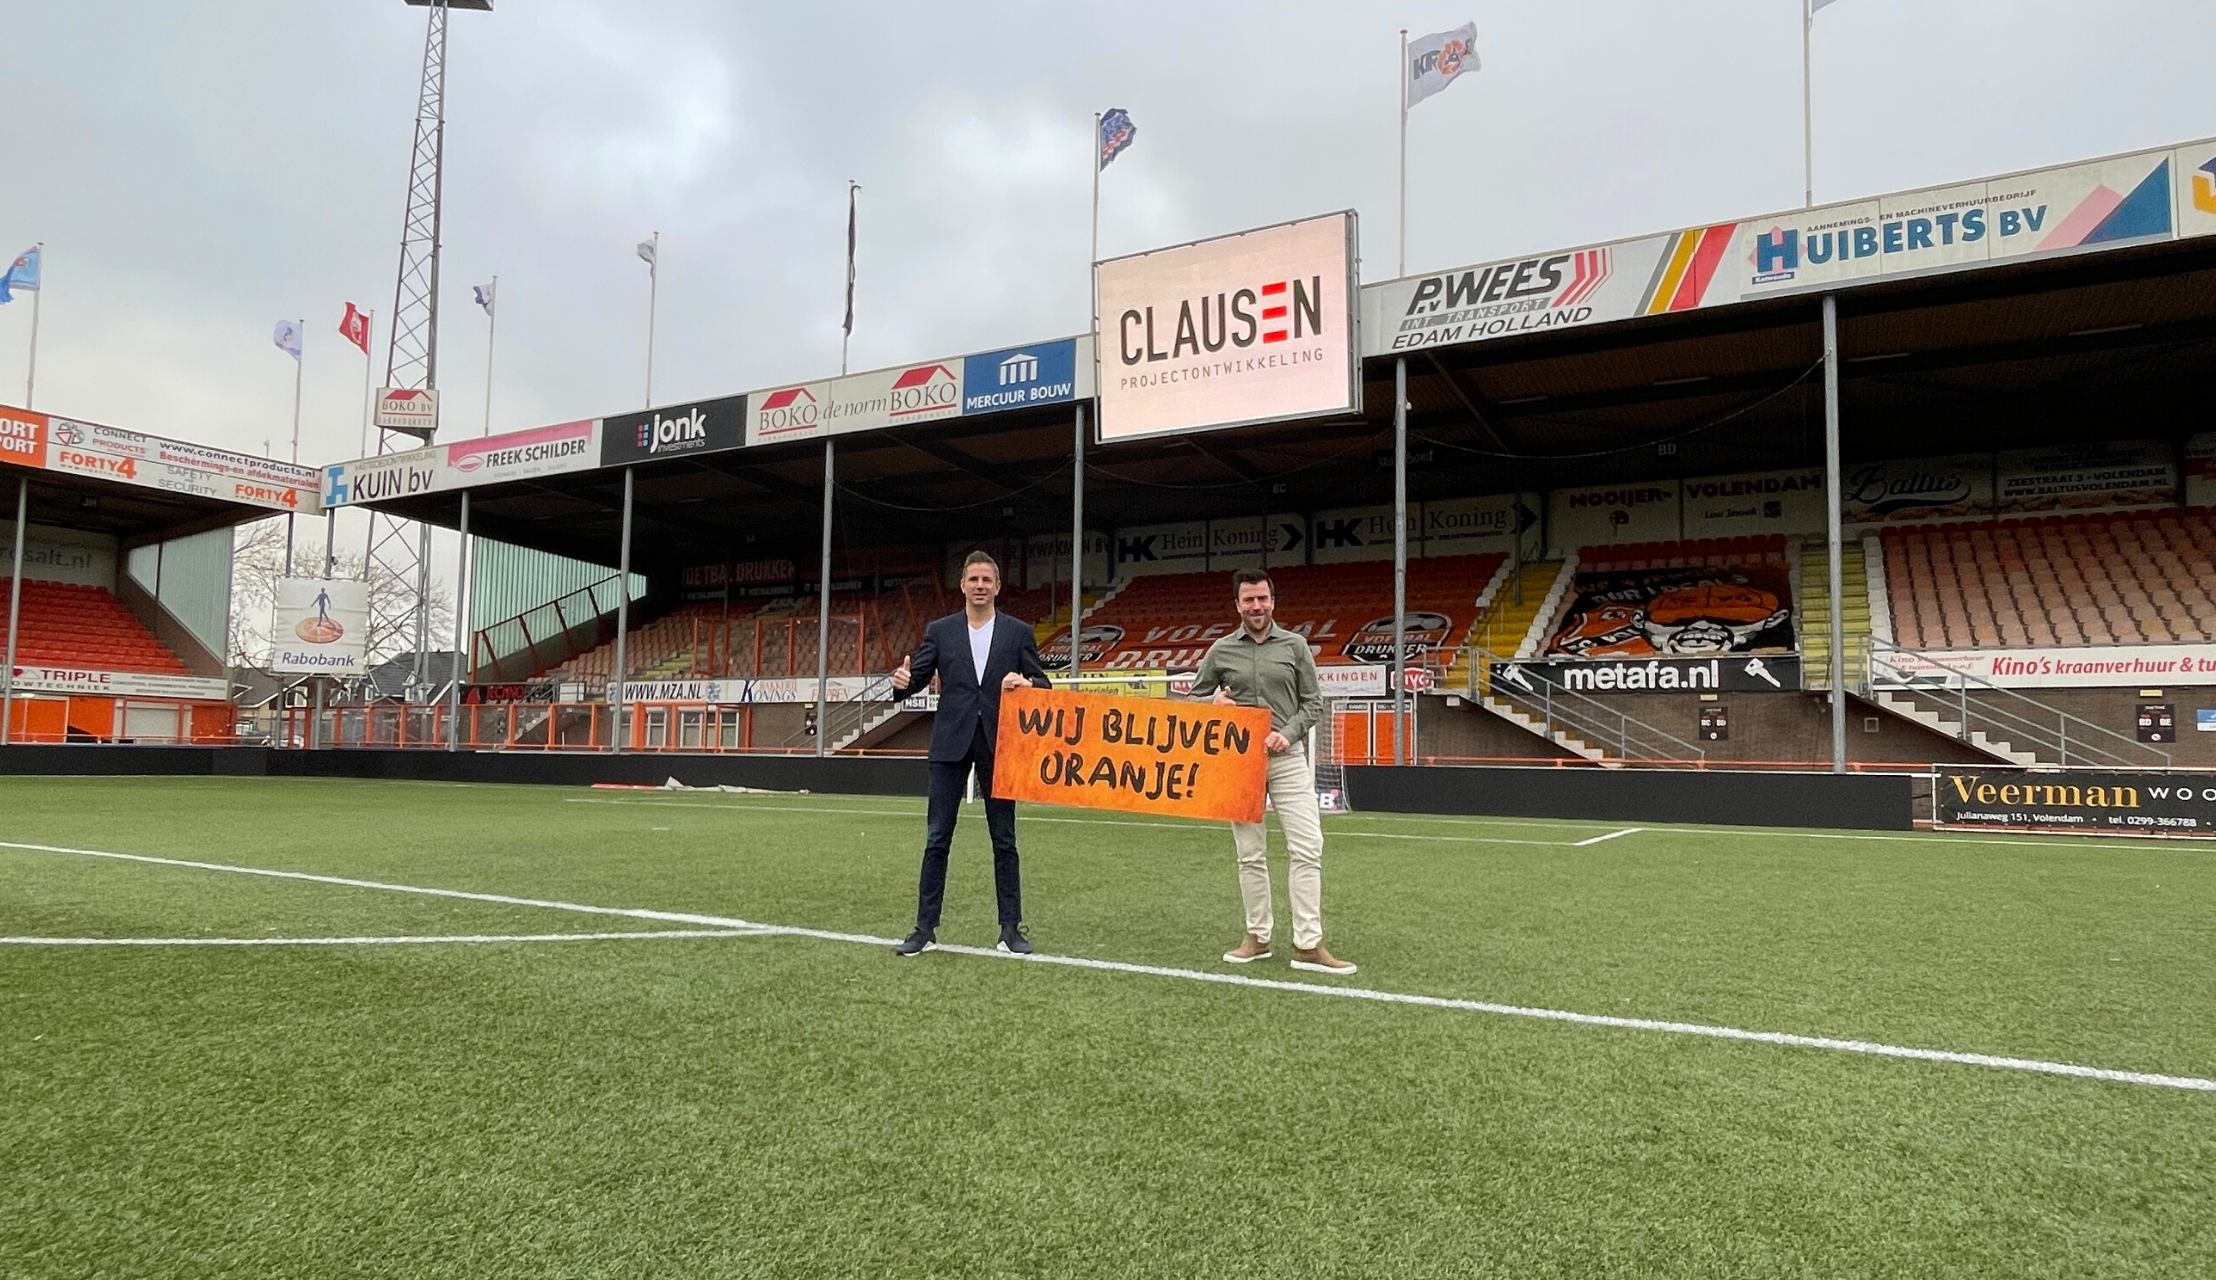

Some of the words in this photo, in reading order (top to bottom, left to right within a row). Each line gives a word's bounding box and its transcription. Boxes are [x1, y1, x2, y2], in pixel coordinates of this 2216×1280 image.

[1880, 212, 1893, 221] EN
[1896, 190, 2037, 218] MACHINEVERHUURBEDRIJF
[2000, 205, 2048, 237] BV
[1120, 275, 1322, 366] CLAUSEN
[1392, 326, 1463, 350] EDAM
[1468, 307, 1593, 338] HOLLAND
[1404, 316, 1436, 331] INT.
[1446, 299, 1545, 324] TRANSPORT
[1121, 348, 1323, 390] PROJECTONTWIKKELING
[382, 400, 416, 411] BOKO
[823, 400, 841, 420] de
[844, 397, 887, 418] norm
[890, 382, 957, 411] BOKO
[967, 389, 1025, 410] MERCUUR
[1030, 382, 1072, 400] BOUW
[0, 436, 38, 454] ORT
[94, 427, 147, 443] CONNECT
[651, 408, 706, 454] jonk
[92, 438, 146, 454] PRODUCTS
[486, 449, 523, 468] FREEK
[525, 439, 586, 462] SCHILDER
[657, 438, 706, 453] investments
[159, 441, 316, 479] www.connectproducts.nl
[167, 465, 213, 481] SAFETY
[158, 478, 217, 496] SECURITY
[247, 469, 319, 490] afdekmaterialen
[353, 468, 402, 501] KUIN
[408, 466, 434, 493] bv
[1687, 473, 1821, 499] VOLENDAM
[2004, 478, 2170, 497] WWW.BALTUSVOLENDAM.NL
[2007, 475, 2073, 487] ZEESTRAAT
[2076, 474, 2084, 482] 3
[2094, 467, 2167, 480] VOLENDAM
[1316, 518, 1363, 549] HK
[1369, 516, 1416, 534] Hen
[1430, 507, 1508, 529] Koning
[1118, 537, 1157, 563] HK
[1162, 532, 1204, 551] Hein
[282, 651, 356, 667] Rabobank
[1992, 656, 2051, 676] Kino's
[2056, 657, 2177, 675] kraanverhuur
[2179, 656, 2194, 672] &
[41, 669, 112, 684] TRIPLE
[1563, 660, 1720, 690] metafa.nl
[624, 682, 702, 701] WWW.MZA.NL
[1019, 706, 1085, 746] WIJ
[1102, 708, 1251, 756] BLIJVEN
[1041, 750, 1200, 801] ORANJE!
[1949, 775, 2141, 809] Veerman
[1956, 810, 2009, 823] Julianaweg
[2010, 812, 2031, 823] 151,
[2033, 813, 2084, 824] Volendam
[2108, 815, 2126, 825] tel.
[2126, 816, 2198, 827] 0299-366788
